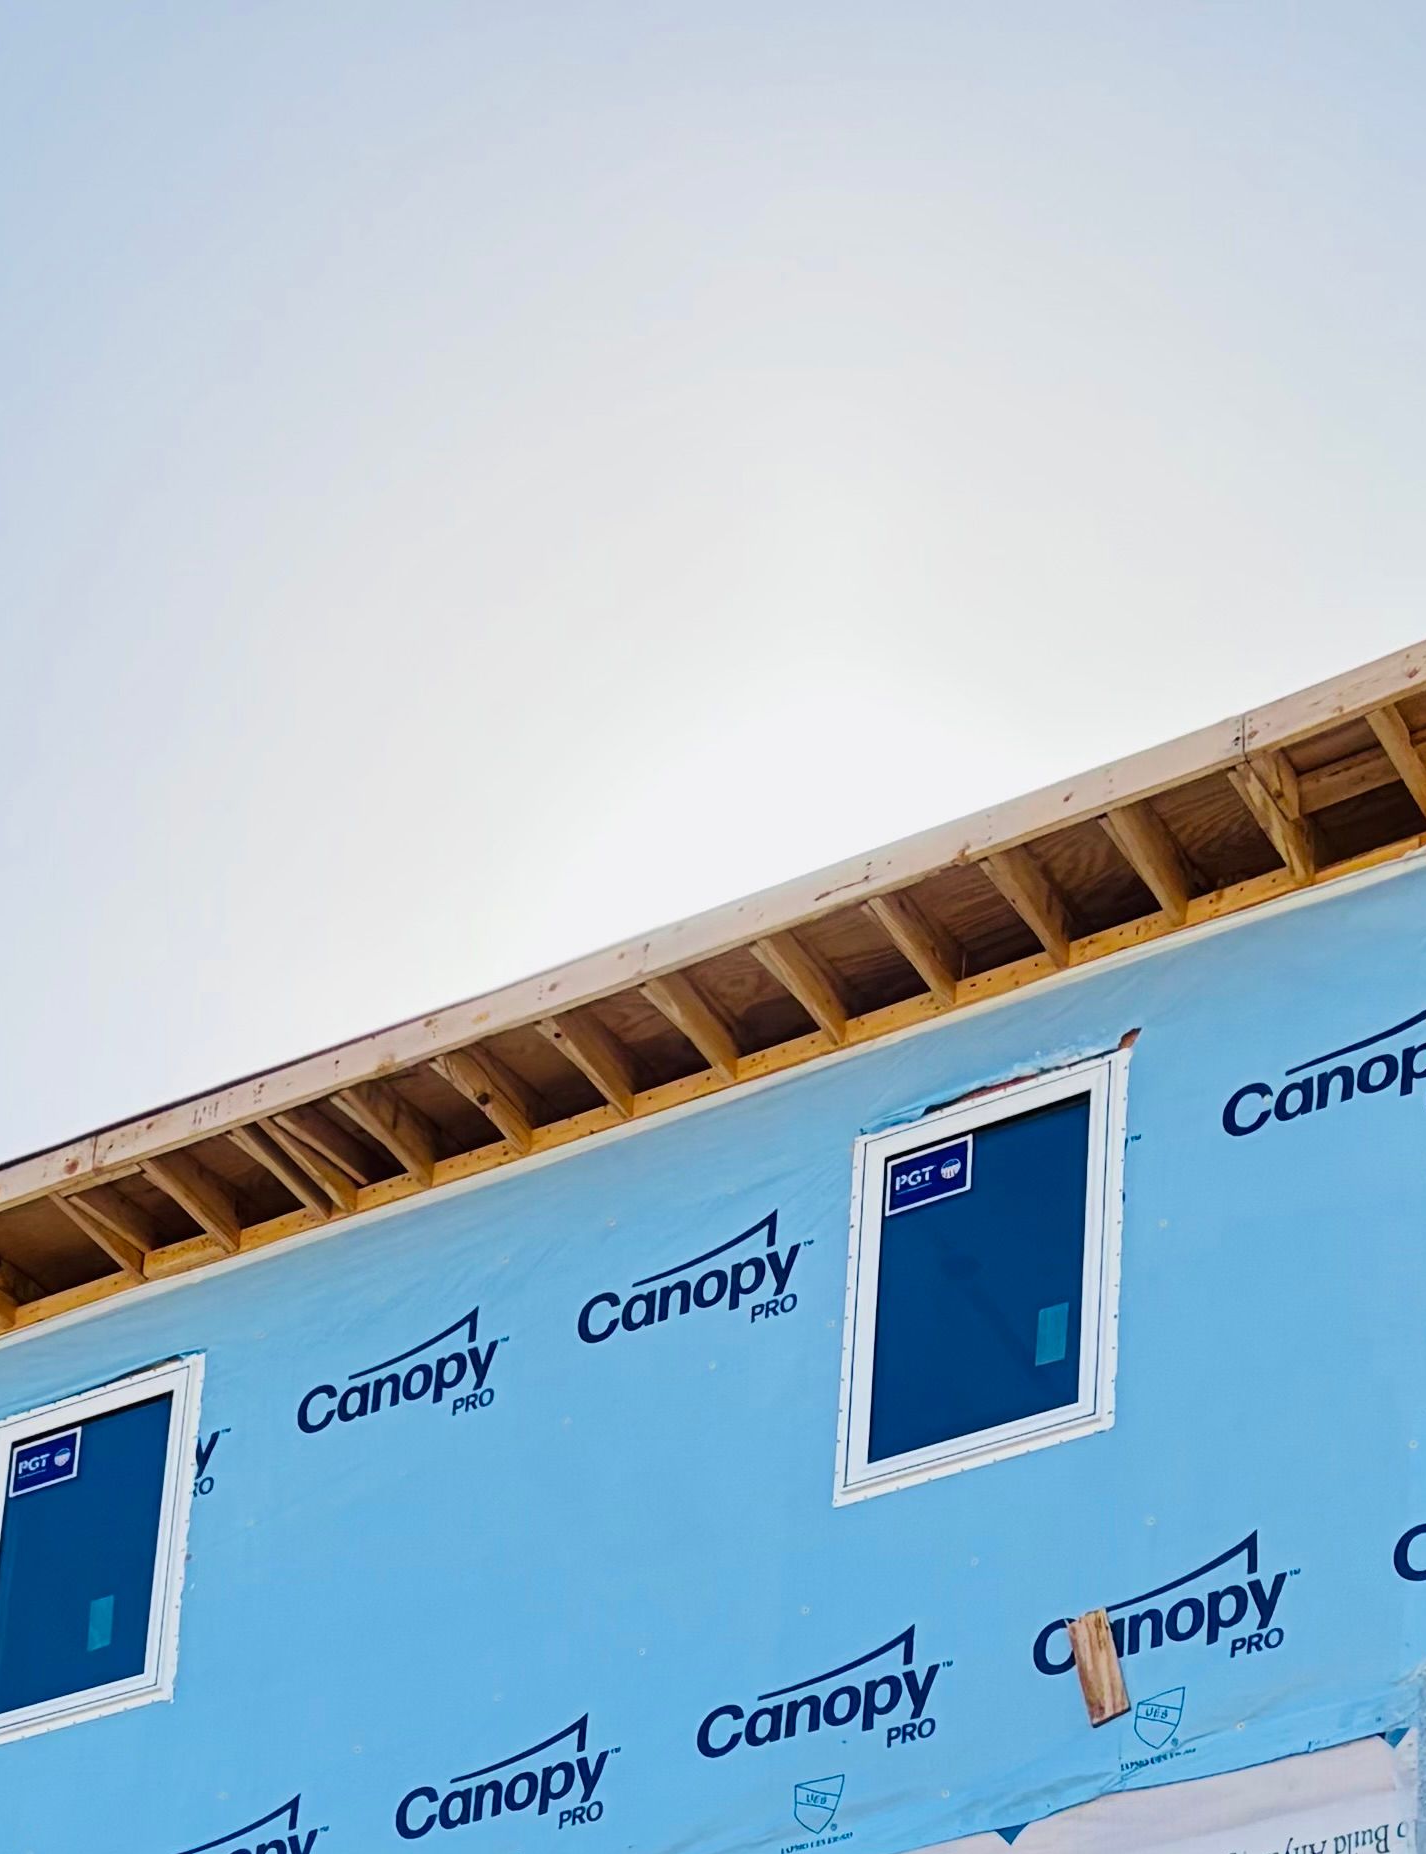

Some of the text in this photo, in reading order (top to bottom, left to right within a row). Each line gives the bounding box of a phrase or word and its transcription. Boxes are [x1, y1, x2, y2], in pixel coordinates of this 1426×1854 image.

[895, 1166, 933, 1190] PGT
[577, 1242, 802, 1344] Canopy
[751, 1294, 798, 1324] PRO
[297, 1339, 500, 1434] Canopy
[452, 1388, 494, 1416] PRO
[19, 1455, 49, 1476] PGT
[1033, 1571, 1288, 1677] Cnopy
[1230, 1627, 1284, 1658] PRO
[695, 1662, 942, 1759] Canopy
[887, 1718, 937, 1748] PRO
[394, 1749, 609, 1841] Canopy
[558, 1801, 604, 1830] PRO
